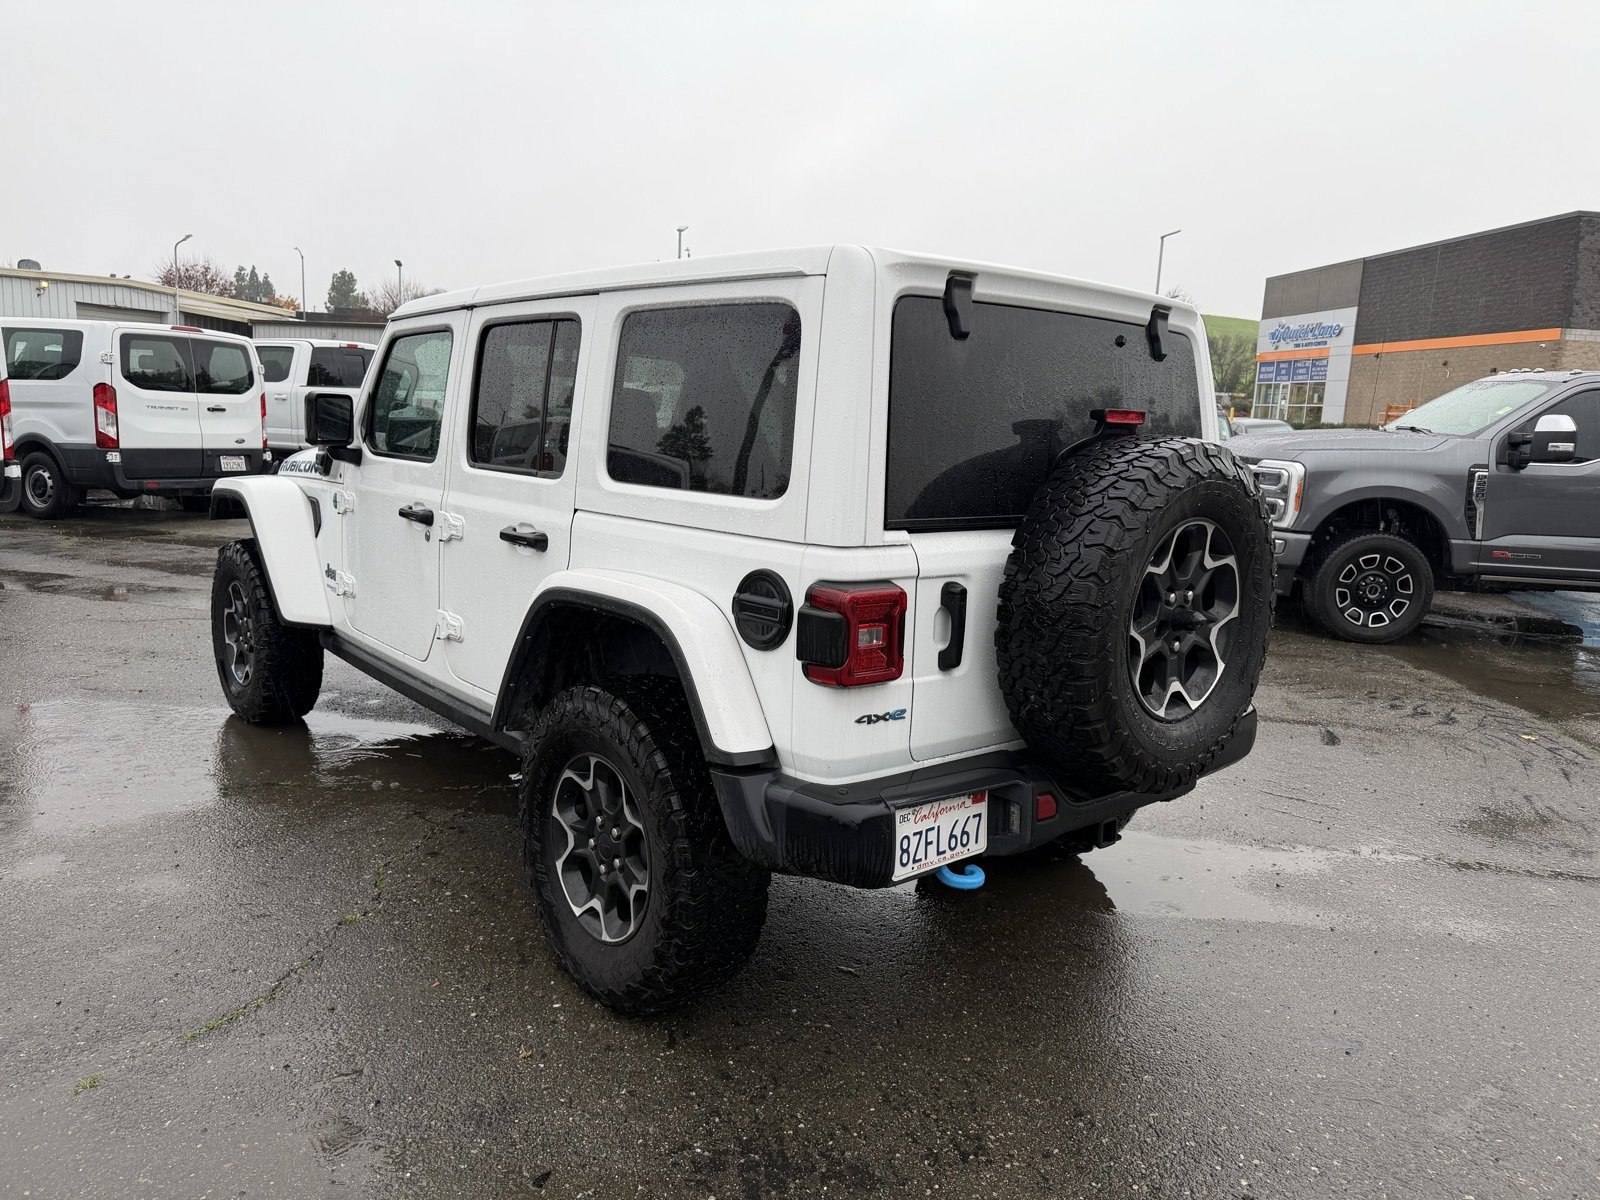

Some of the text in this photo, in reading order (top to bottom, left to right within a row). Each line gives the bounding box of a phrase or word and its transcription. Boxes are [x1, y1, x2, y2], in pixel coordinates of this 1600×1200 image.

[1282, 323, 1341, 341] Quick Lane
[899, 801, 971, 825] DEC California
[899, 812, 982, 867] 8ZFL667
[916, 850, 966, 870] dmv.ca.gov
